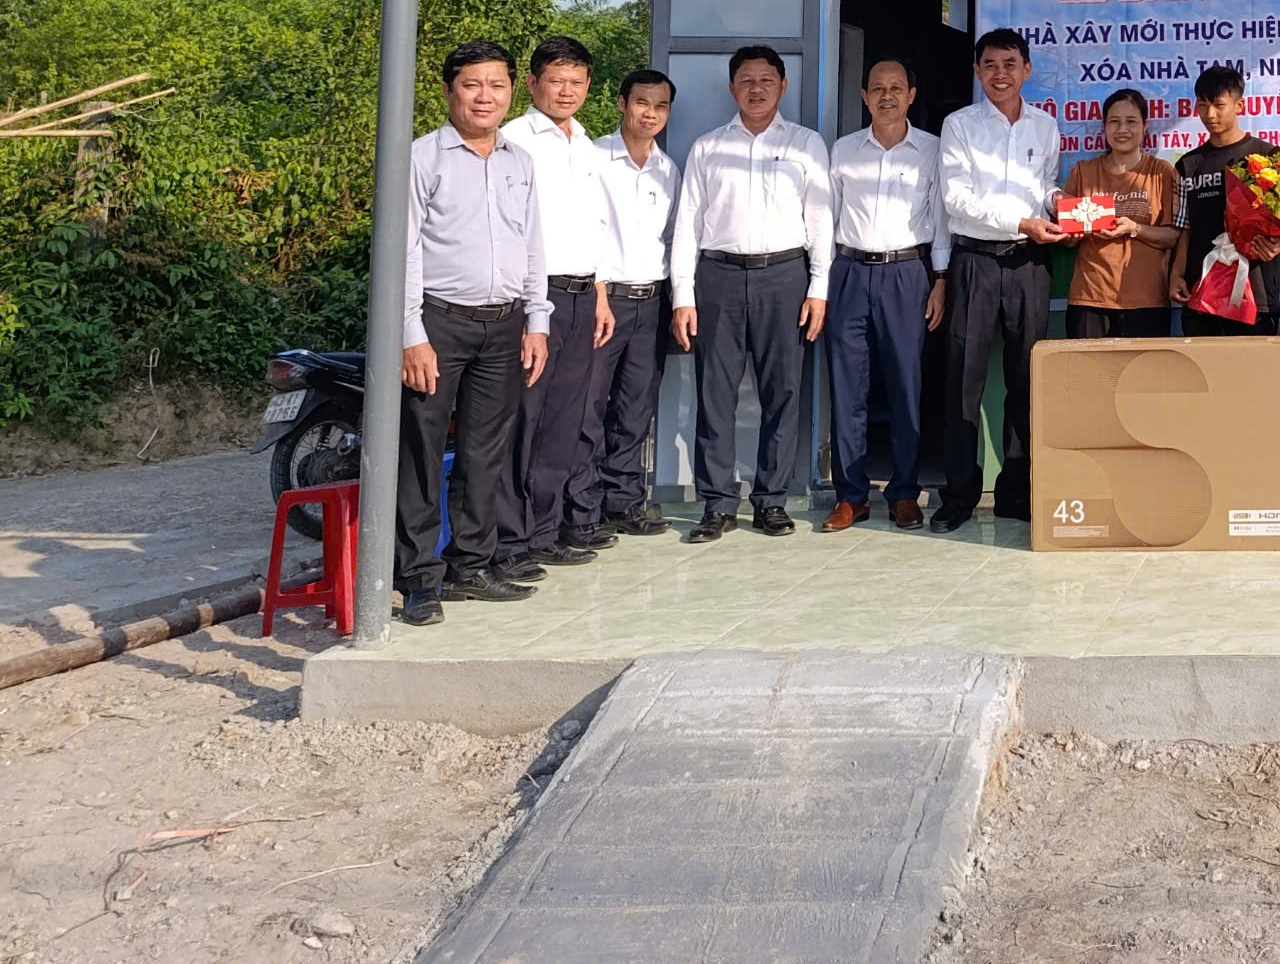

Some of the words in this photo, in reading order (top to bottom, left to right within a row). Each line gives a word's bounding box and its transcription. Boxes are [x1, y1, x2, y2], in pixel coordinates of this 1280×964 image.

[1018, 22, 1058, 45] HÀ
[1065, 21, 1112, 44] XÂY
[1121, 19, 1165, 43] MỚI
[1173, 19, 1234, 45] THỰC
[1080, 58, 1132, 82] XÓA
[1140, 56, 1189, 80] NHÀ
[1065, 101, 1102, 122] GIA
[1162, 130, 1192, 150] TÂY,
[1197, 191, 1220, 199] LONDON
[1053, 500, 1085, 524] 43
